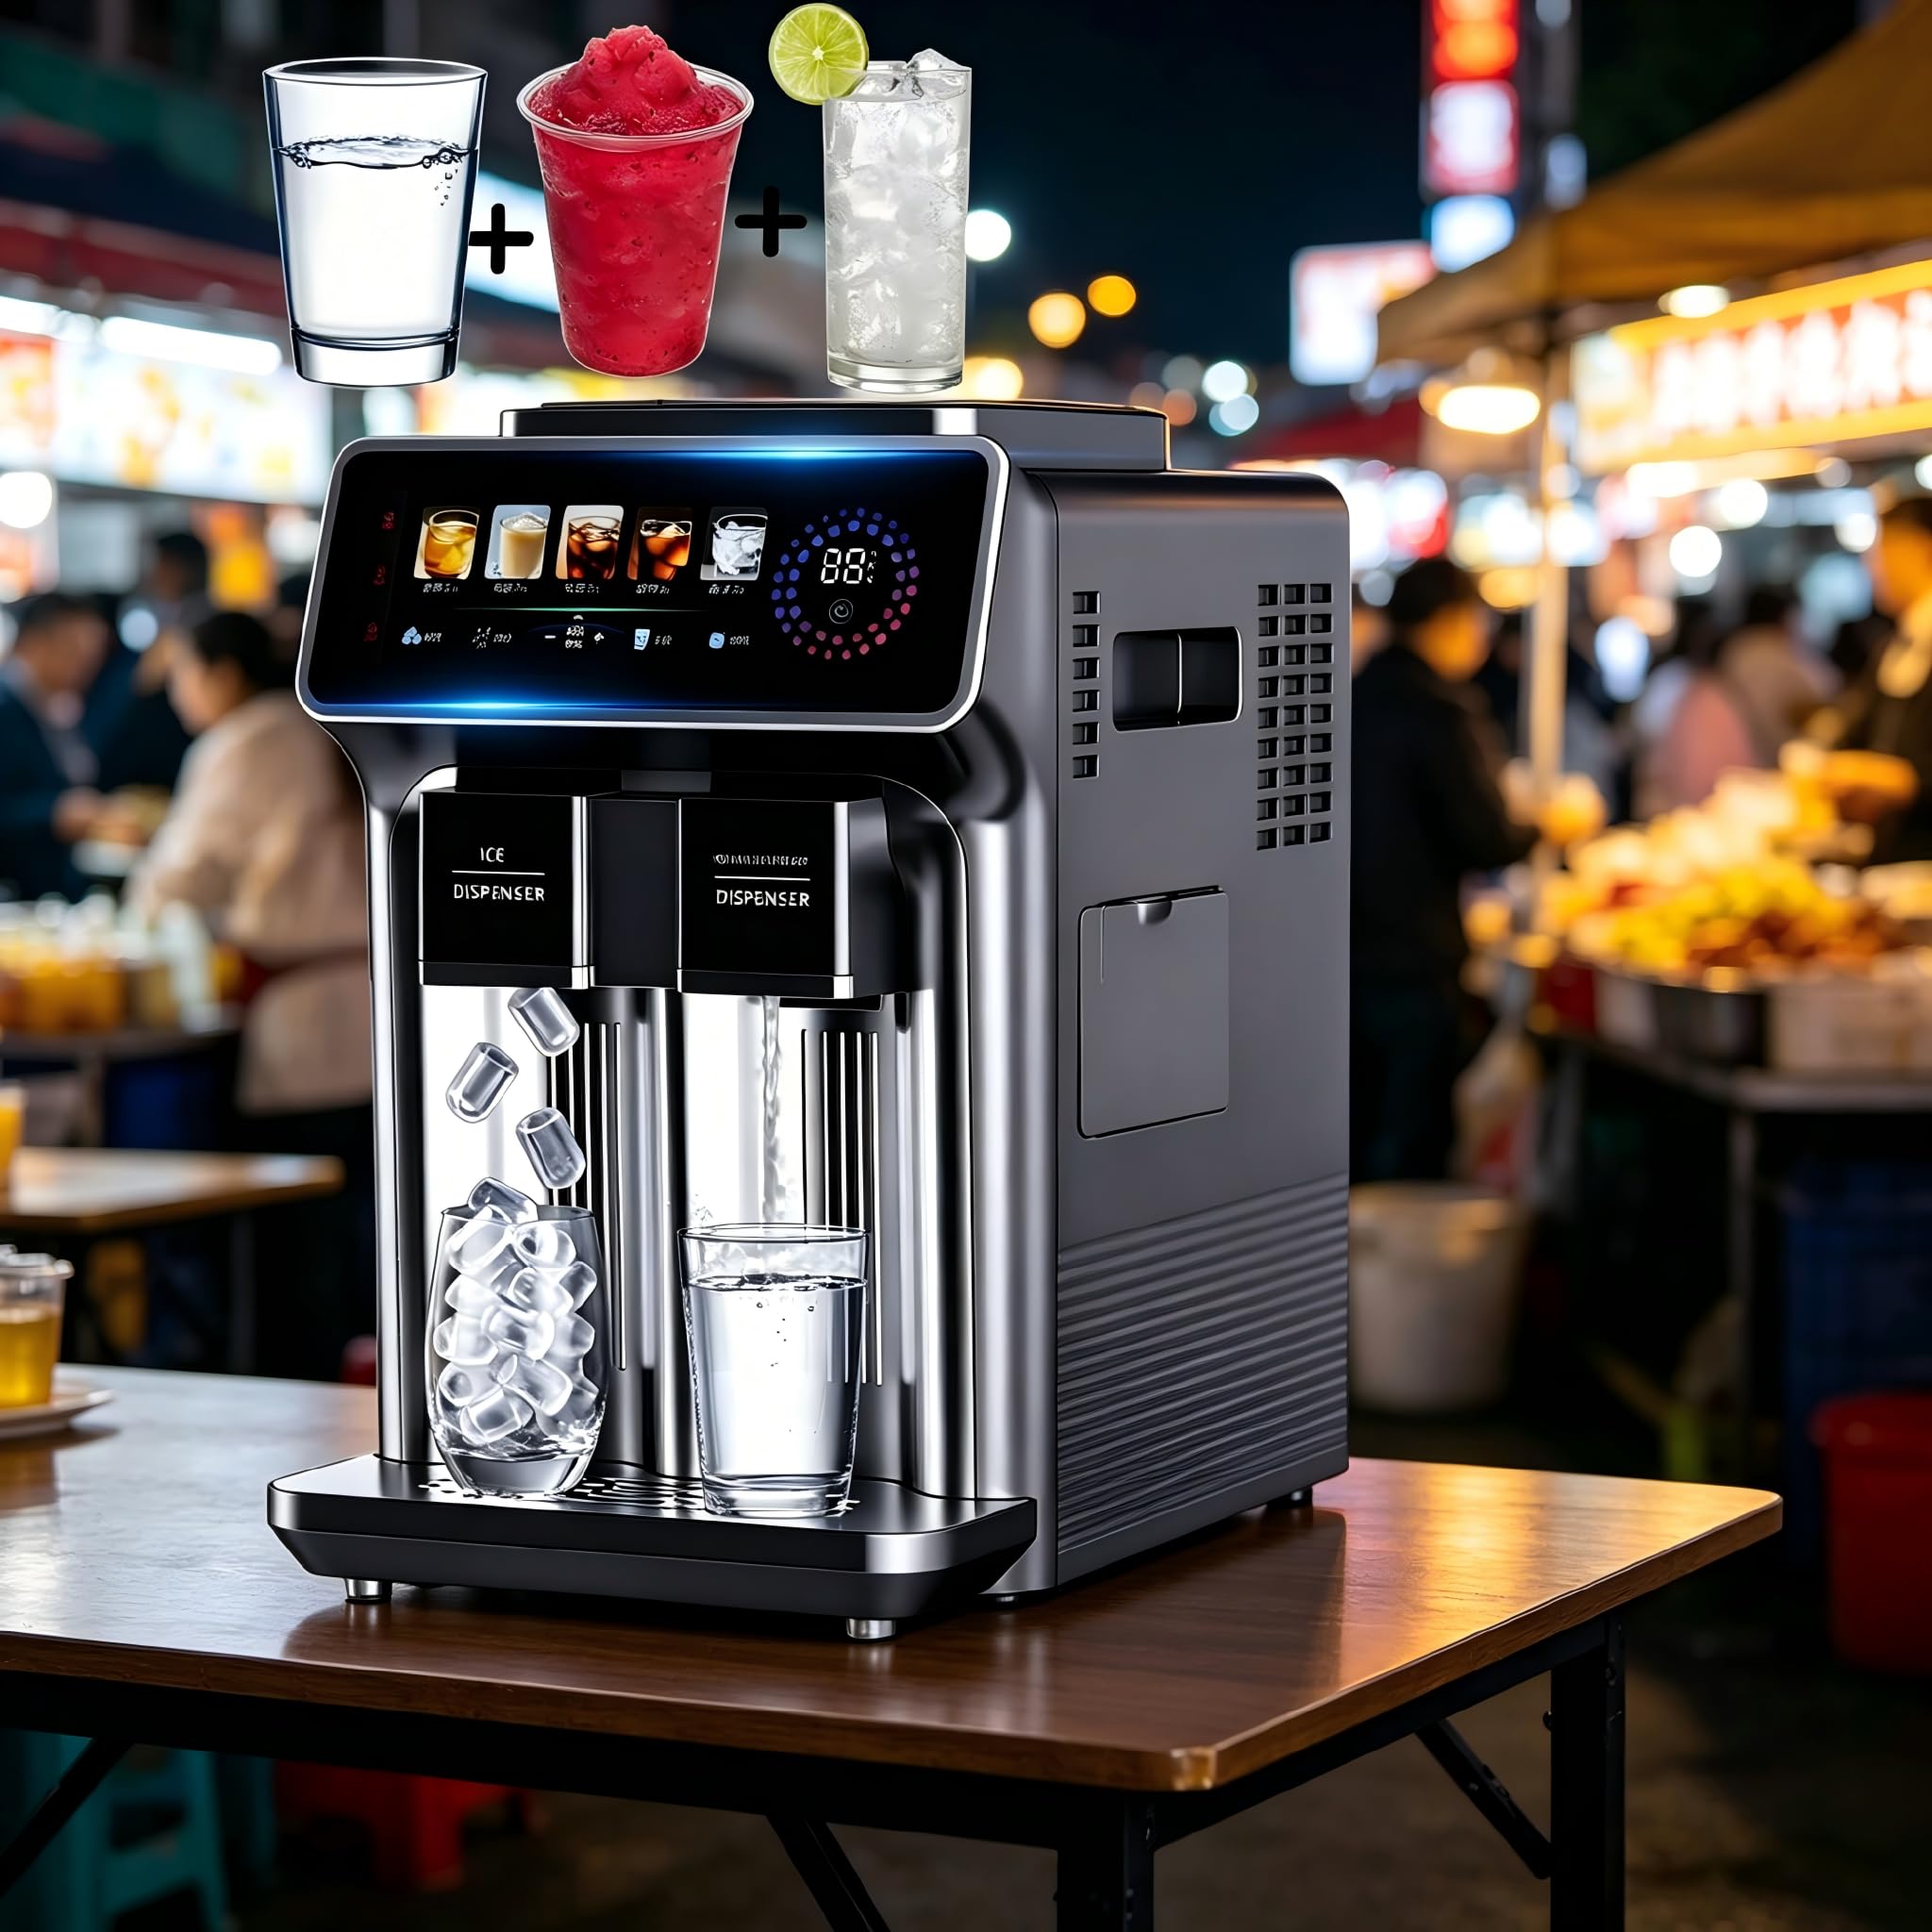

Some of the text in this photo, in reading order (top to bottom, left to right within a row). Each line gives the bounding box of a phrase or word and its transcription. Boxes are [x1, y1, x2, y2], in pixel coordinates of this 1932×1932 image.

[820, 548, 866, 584] 88
[480, 846, 505, 863] ICE
[454, 883, 545, 902] DISPENSER
[716, 889, 810, 908] DISPENSER
